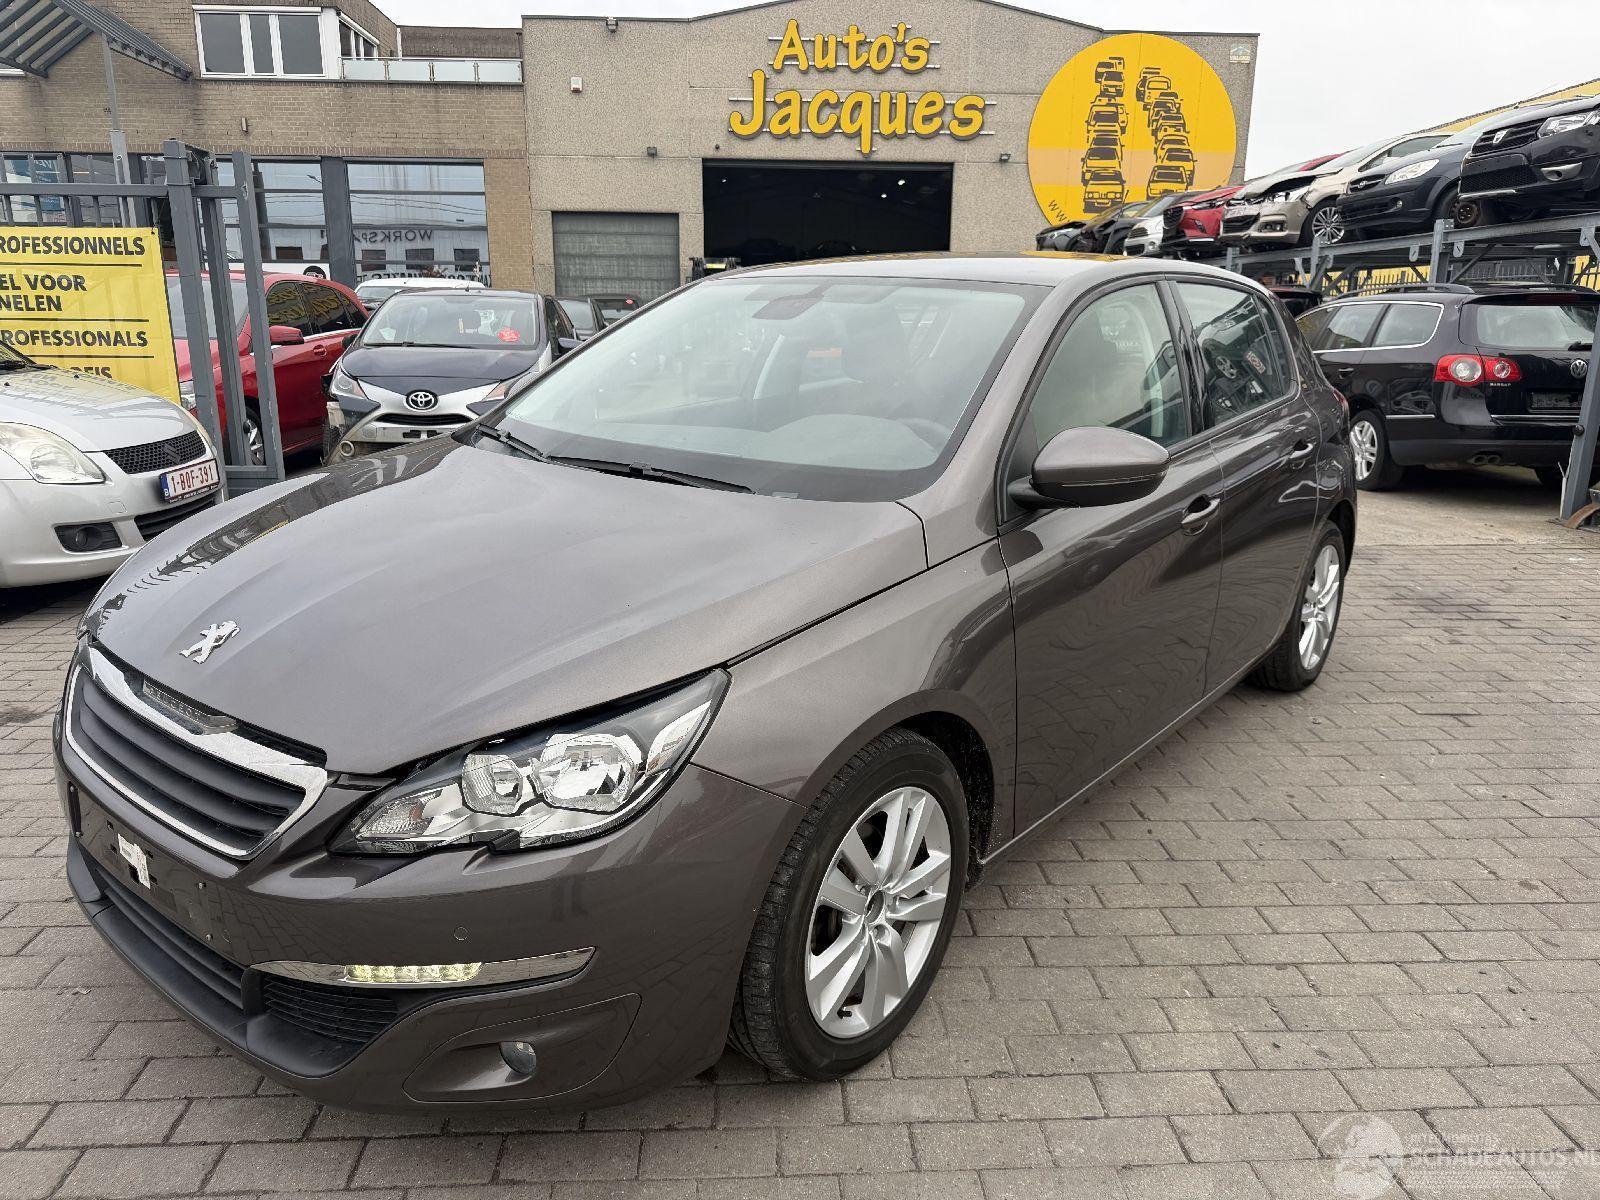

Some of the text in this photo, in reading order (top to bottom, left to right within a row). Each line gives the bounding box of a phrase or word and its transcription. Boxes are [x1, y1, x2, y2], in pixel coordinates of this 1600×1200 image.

[773, 18, 931, 73] Auto's
[729, 69, 986, 158] Jacques
[0, 274, 87, 291] EL VOOR
[1, 329, 148, 347] ROFESSIONALS
